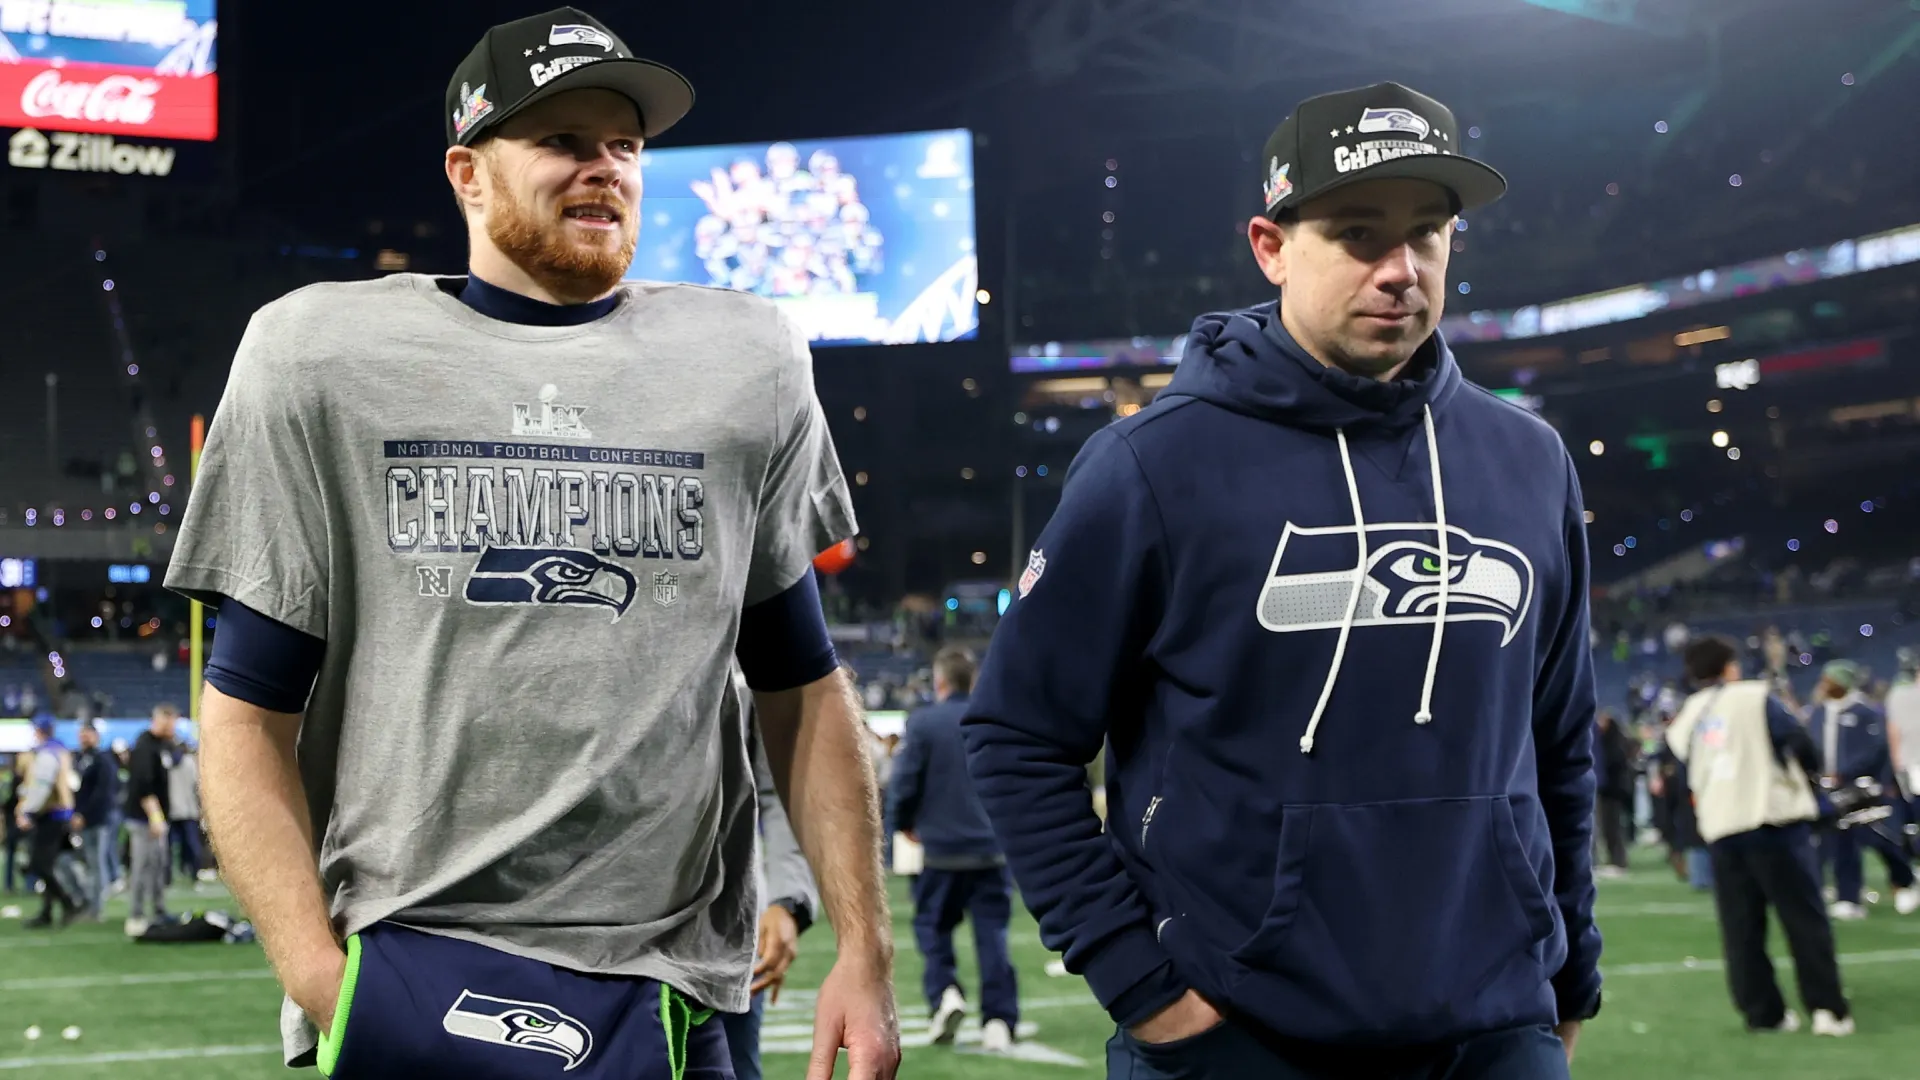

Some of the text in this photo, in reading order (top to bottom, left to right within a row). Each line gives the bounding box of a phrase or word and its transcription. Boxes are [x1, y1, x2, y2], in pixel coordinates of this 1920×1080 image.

[51, 131, 175, 176] Zillow
[397, 443, 693, 467] NATIONAL FOOTBALL CONFERENCE
[386, 466, 704, 560] CHAMPIONS
[656, 585, 678, 603] NFL
